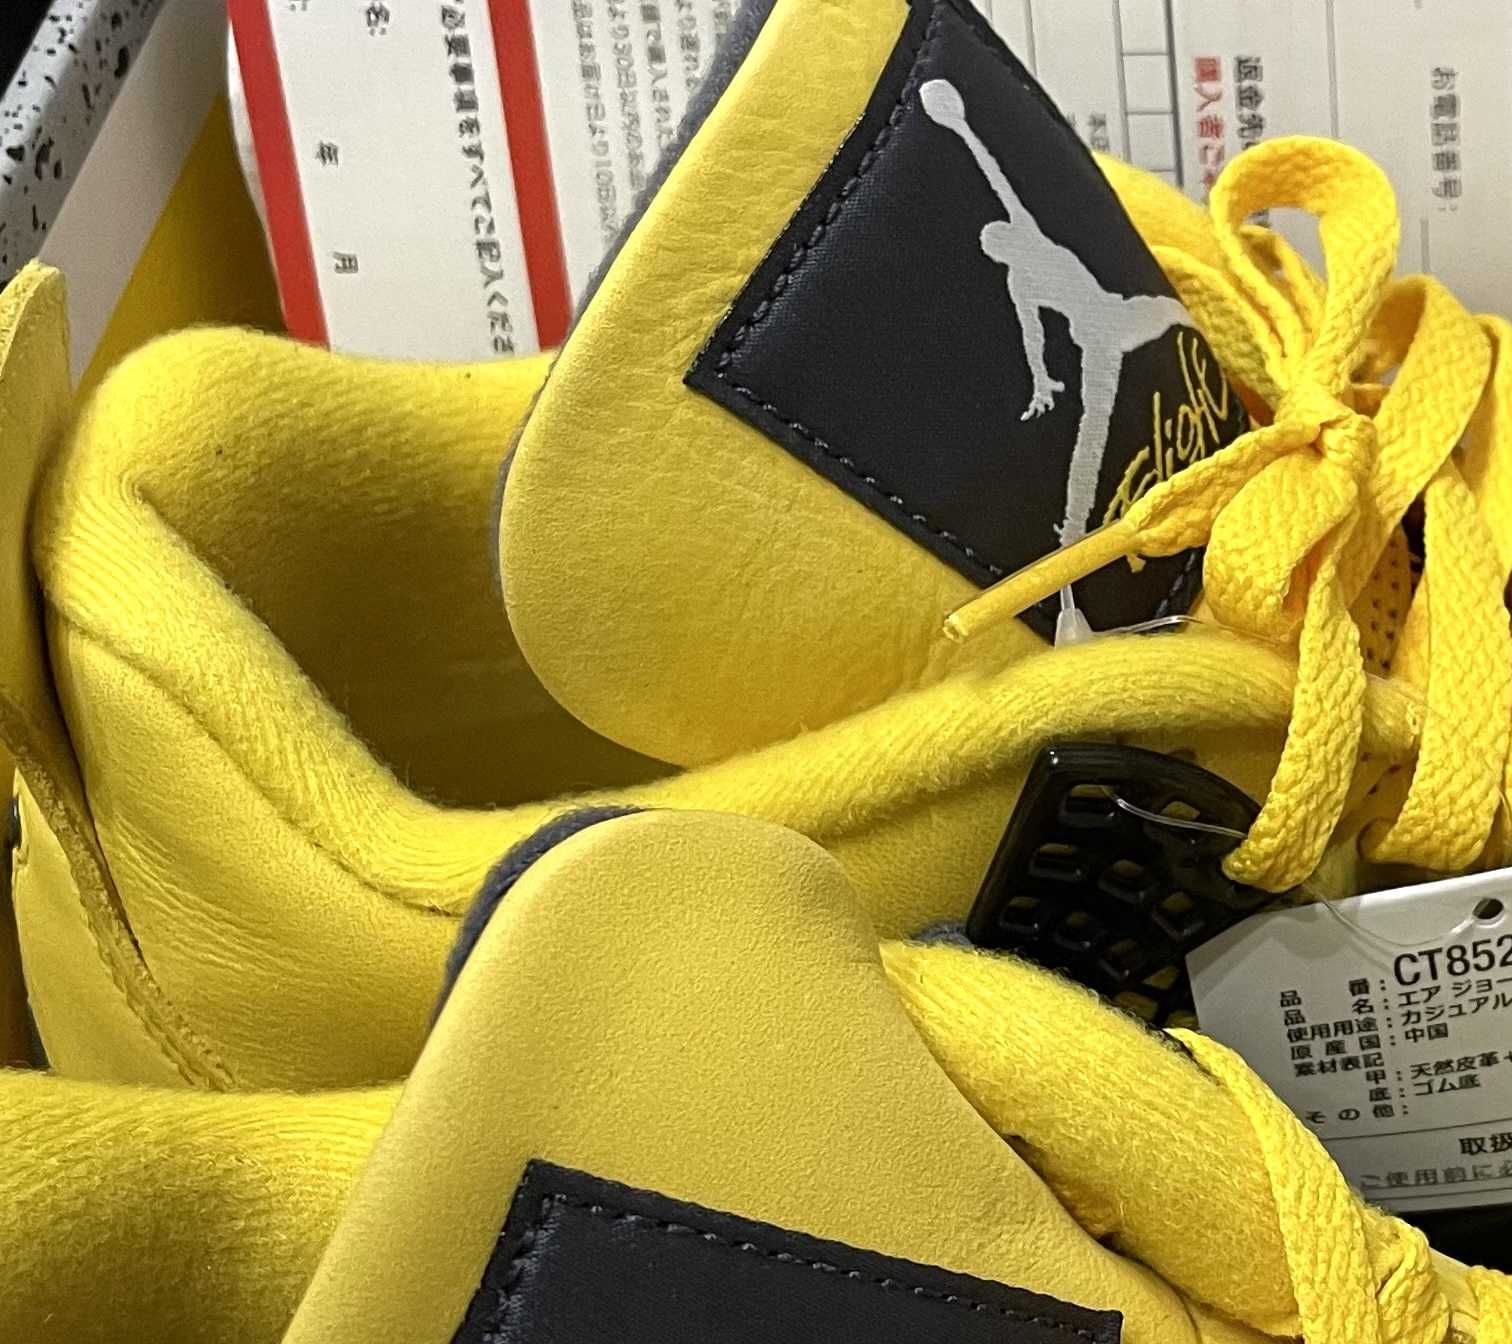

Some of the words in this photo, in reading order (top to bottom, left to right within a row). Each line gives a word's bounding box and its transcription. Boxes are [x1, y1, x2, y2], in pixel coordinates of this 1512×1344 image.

[333, 252, 359, 275] 月
[1398, 983, 1441, 1008] エア
[1404, 1022, 1449, 1045] 中国
[1293, 1052, 1384, 1079] 素材表記
[1414, 1074, 1482, 1098] ゴム底
